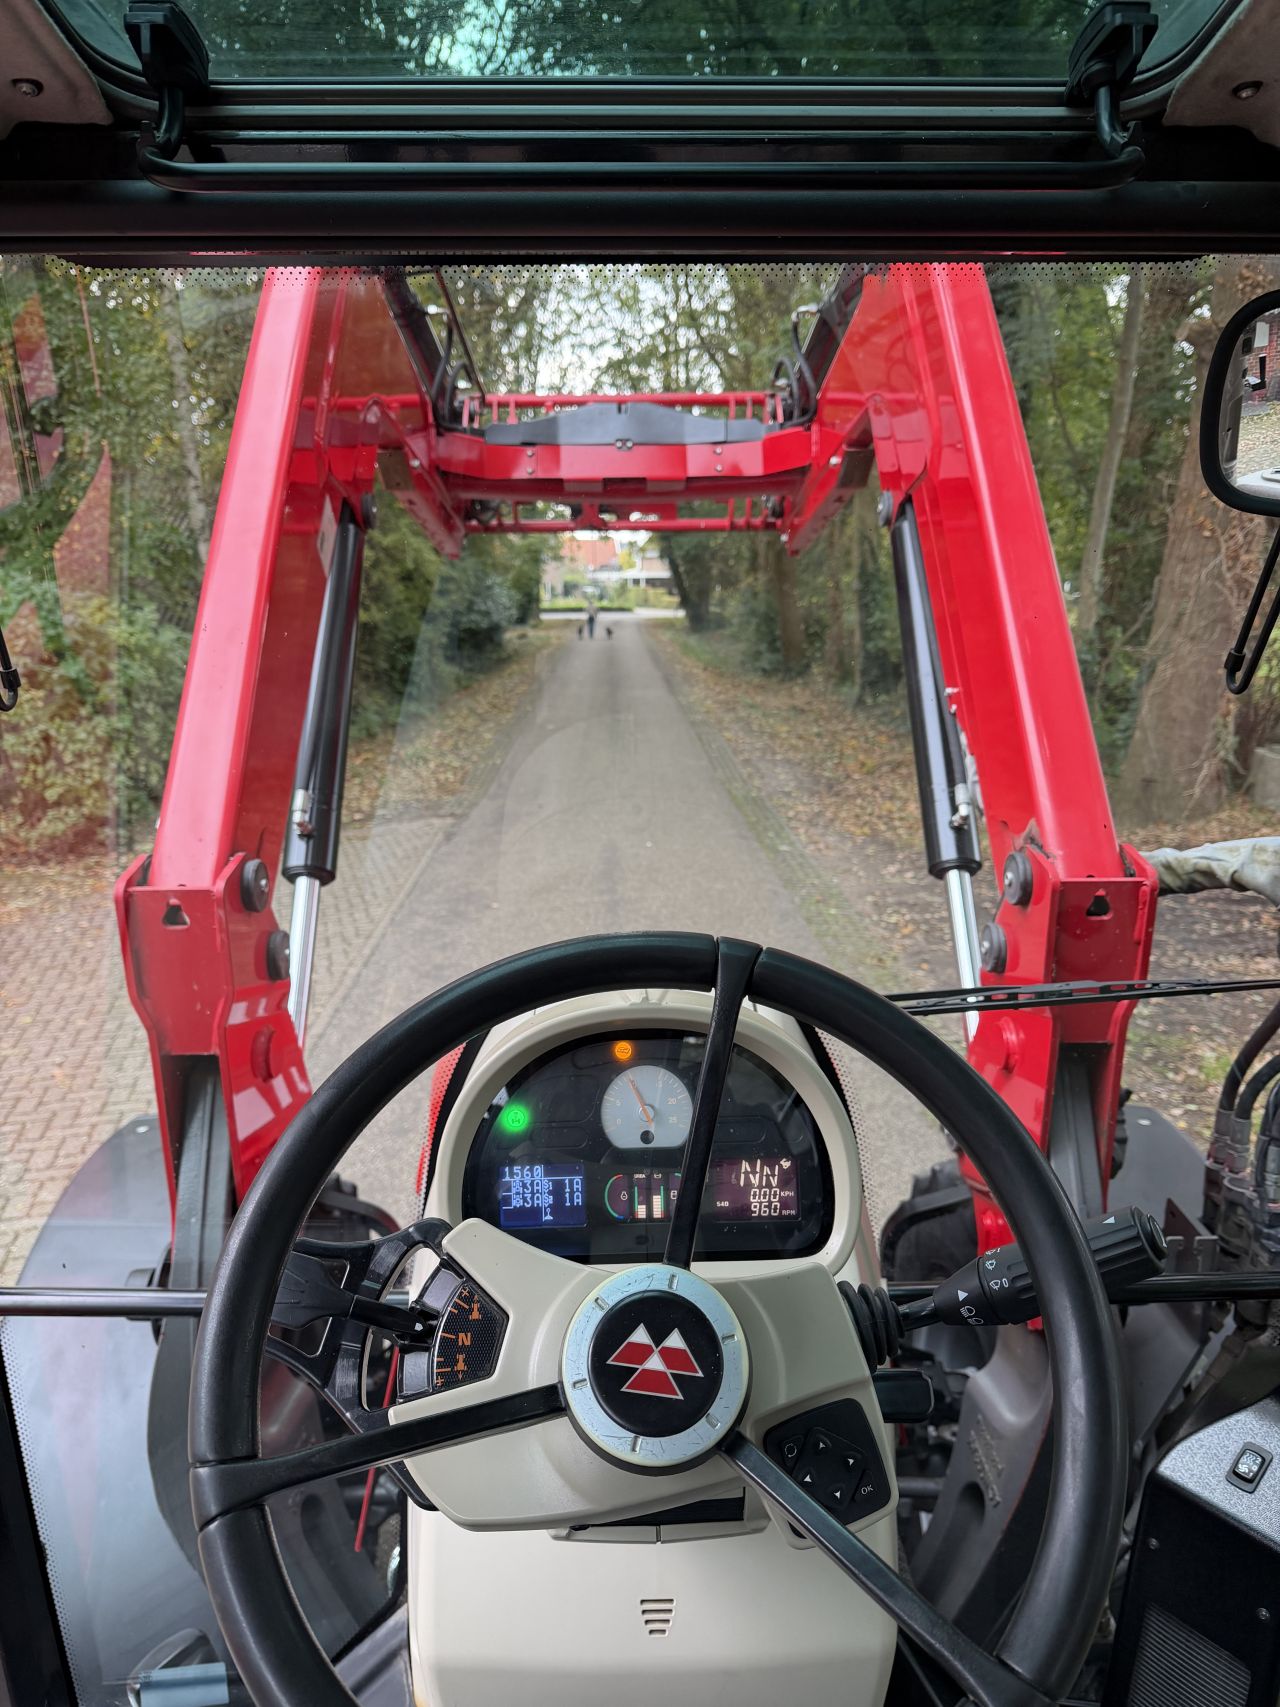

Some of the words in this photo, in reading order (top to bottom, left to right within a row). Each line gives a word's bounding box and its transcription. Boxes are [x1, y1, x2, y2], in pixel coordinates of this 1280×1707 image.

[504, 1166, 542, 1180] 1560
[524, 1180, 542, 1193] 3A
[565, 1178, 582, 1192] 1A
[524, 1194, 542, 1208] 3A
[565, 1192, 582, 1206] 1A
[750, 1188, 780, 1202] 0.00
[751, 1202, 780, 1217] 960
[458, 1332, 472, 1346] N
[861, 1484, 874, 1495] OK
